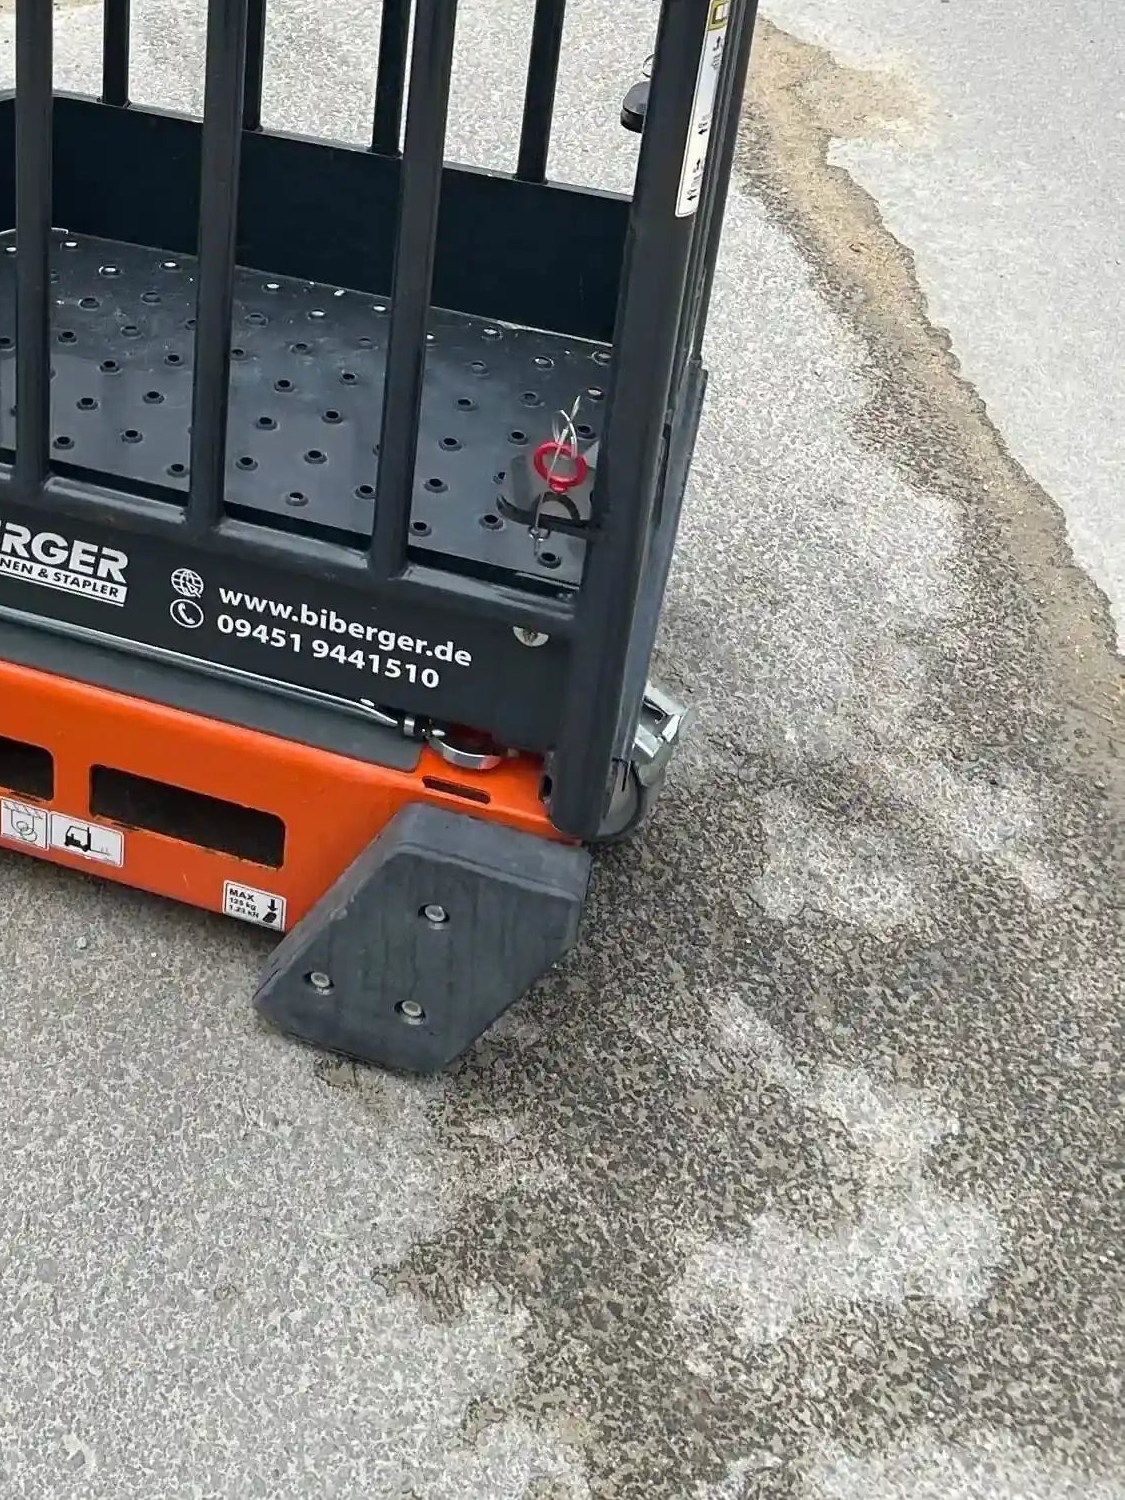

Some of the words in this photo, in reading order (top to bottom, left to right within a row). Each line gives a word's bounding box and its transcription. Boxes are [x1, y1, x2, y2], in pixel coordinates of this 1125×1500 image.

[37, 568, 49, 579] &
[52, 572, 119, 598] STAPLER
[218, 587, 473, 667] www.biberger.de
[217, 614, 302, 653] 09451
[311, 639, 440, 688] 9441510
[229, 888, 255, 902] MAX
[246, 902, 257, 911] kg
